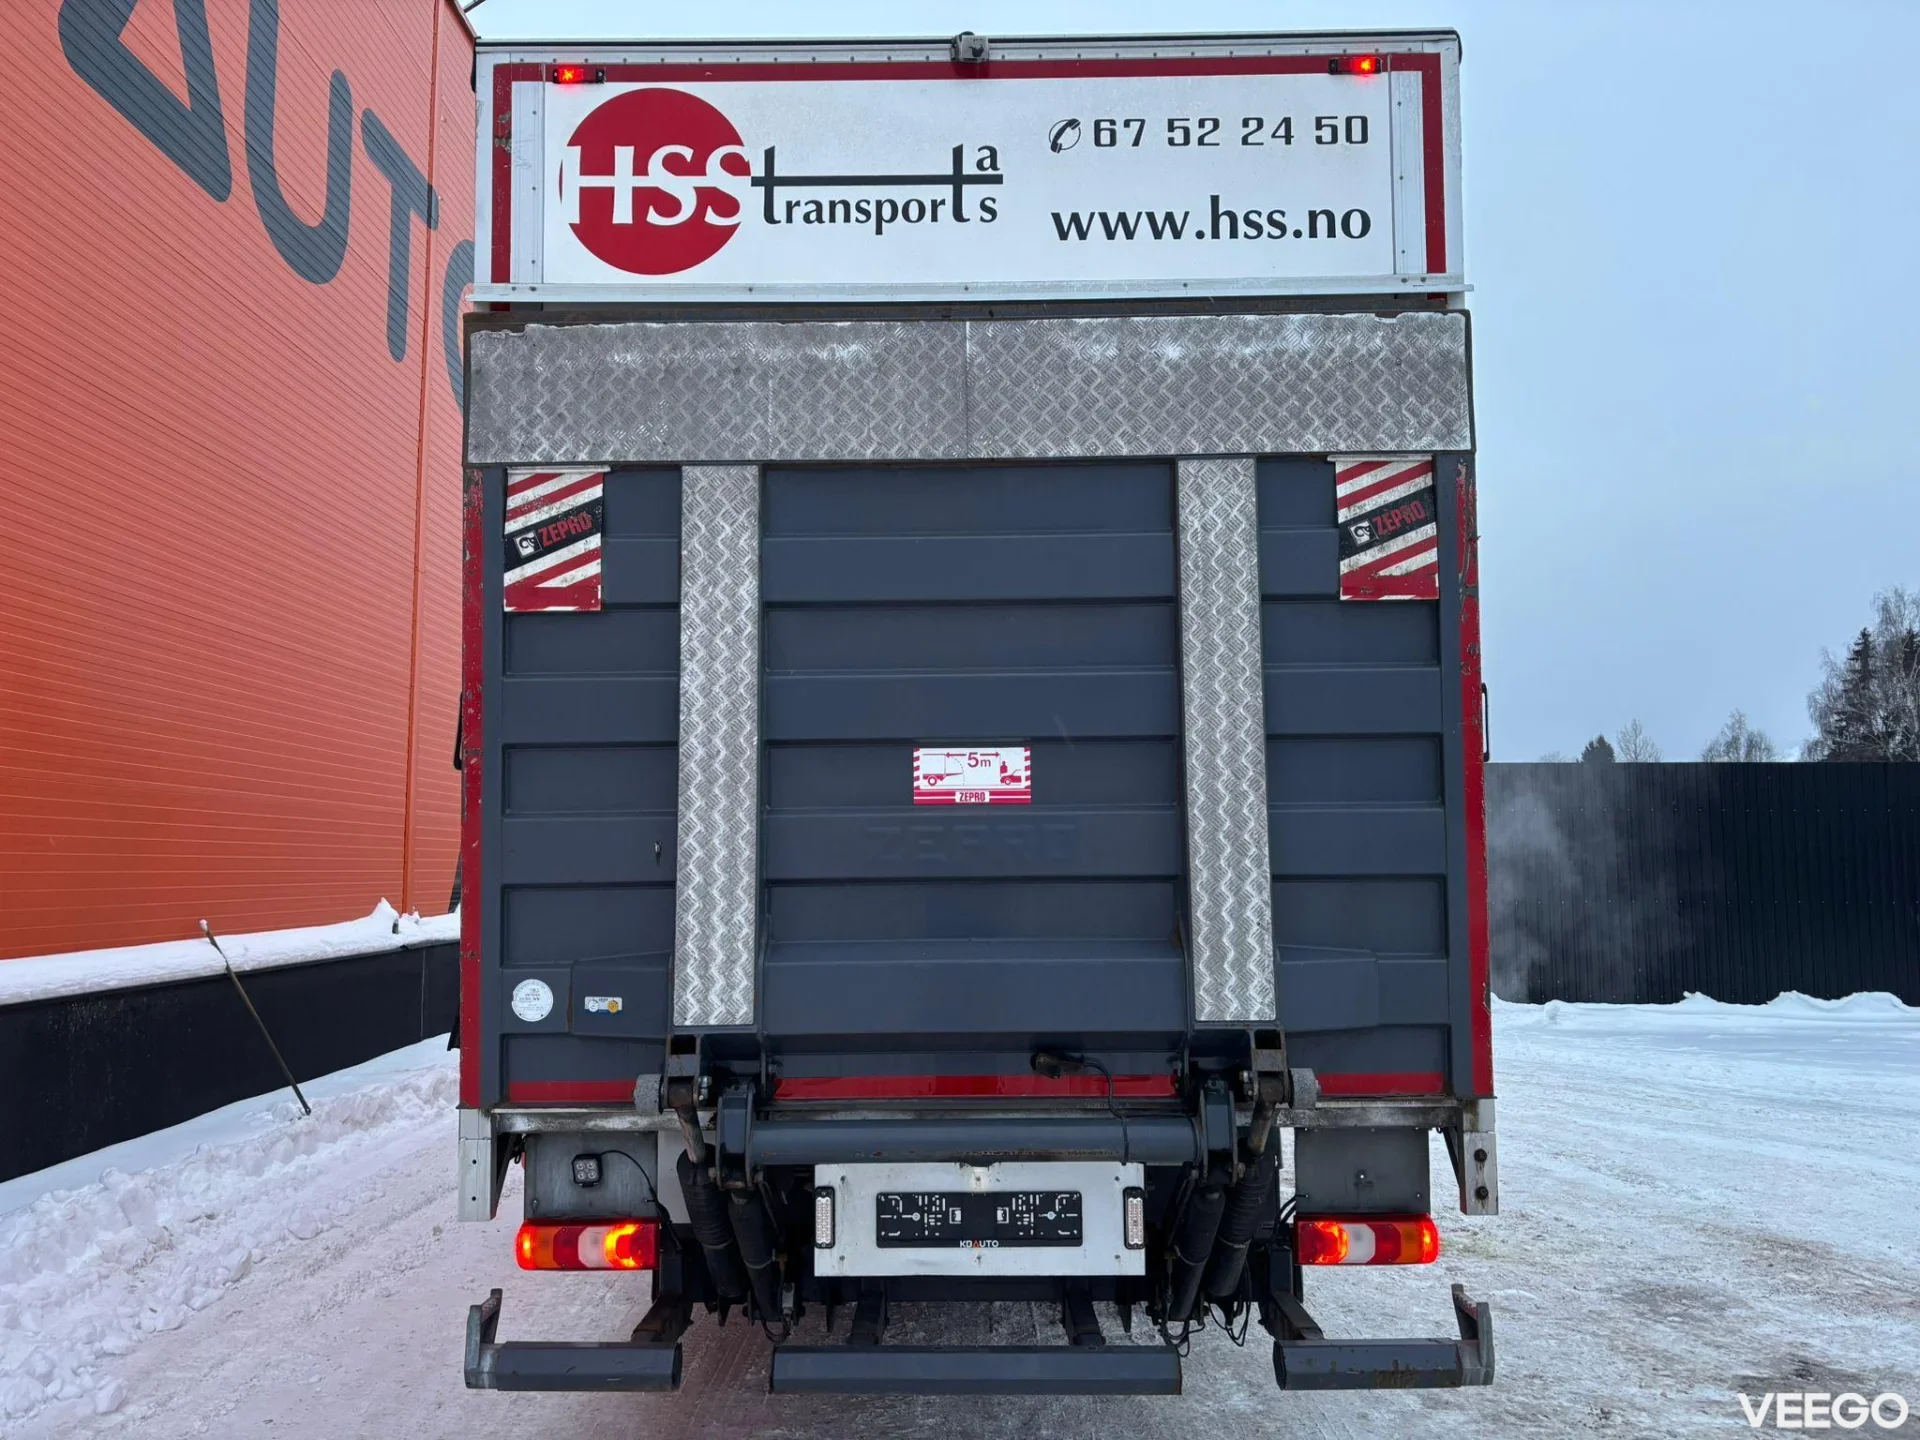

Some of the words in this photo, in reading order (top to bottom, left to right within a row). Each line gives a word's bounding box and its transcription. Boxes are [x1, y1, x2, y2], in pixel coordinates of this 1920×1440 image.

[1093, 118, 1146, 147] 67
[1167, 117, 1220, 147] 52
[1241, 116, 1295, 146] 24
[1314, 115, 1369, 145] 50
[559, 144, 752, 226] HSS
[1050, 194, 1372, 241] www.hss.no
[537, 512, 594, 547] ZEPRO
[1372, 501, 1426, 536] ZEPRO
[959, 792, 986, 802] ZEPRO
